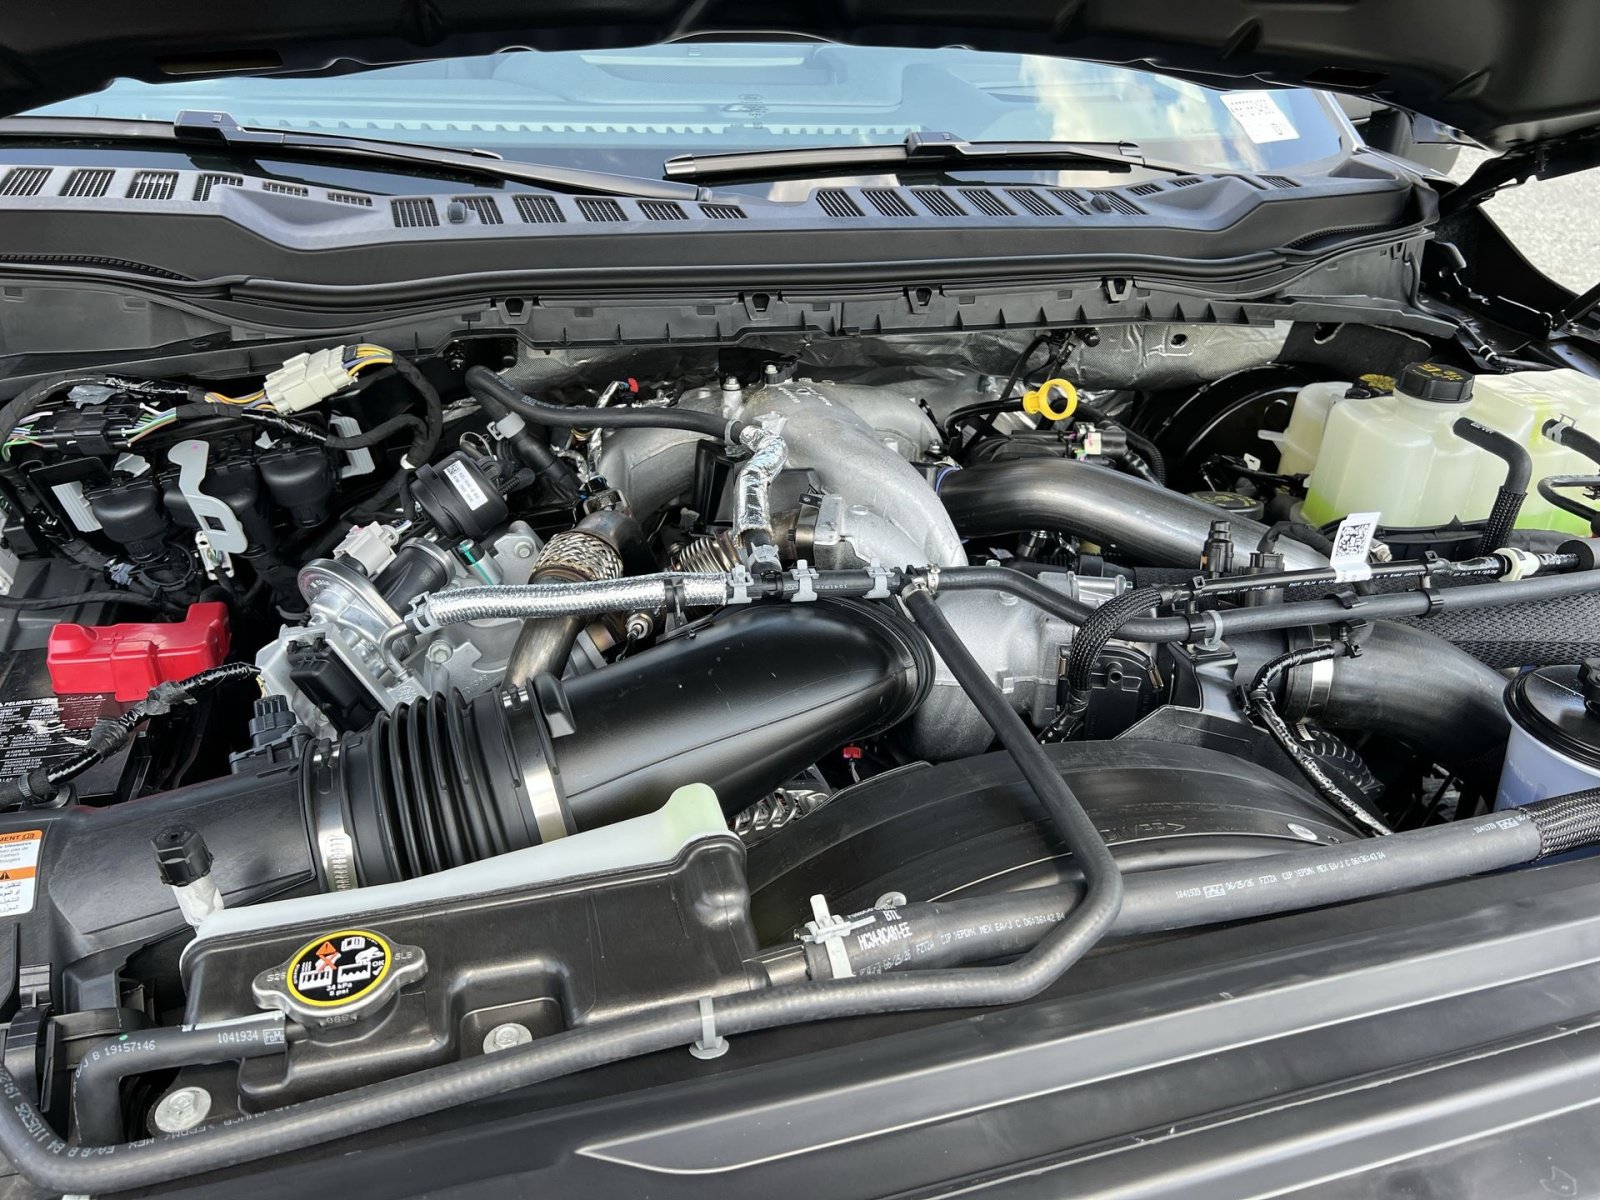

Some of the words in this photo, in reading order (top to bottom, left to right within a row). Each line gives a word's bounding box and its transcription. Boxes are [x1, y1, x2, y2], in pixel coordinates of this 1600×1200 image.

[372, 959, 385, 967] OK
[337, 982, 353, 991] kPa
[217, 1031, 259, 1044] 1041934
[104, 1040, 156, 1057] 19:57:46
